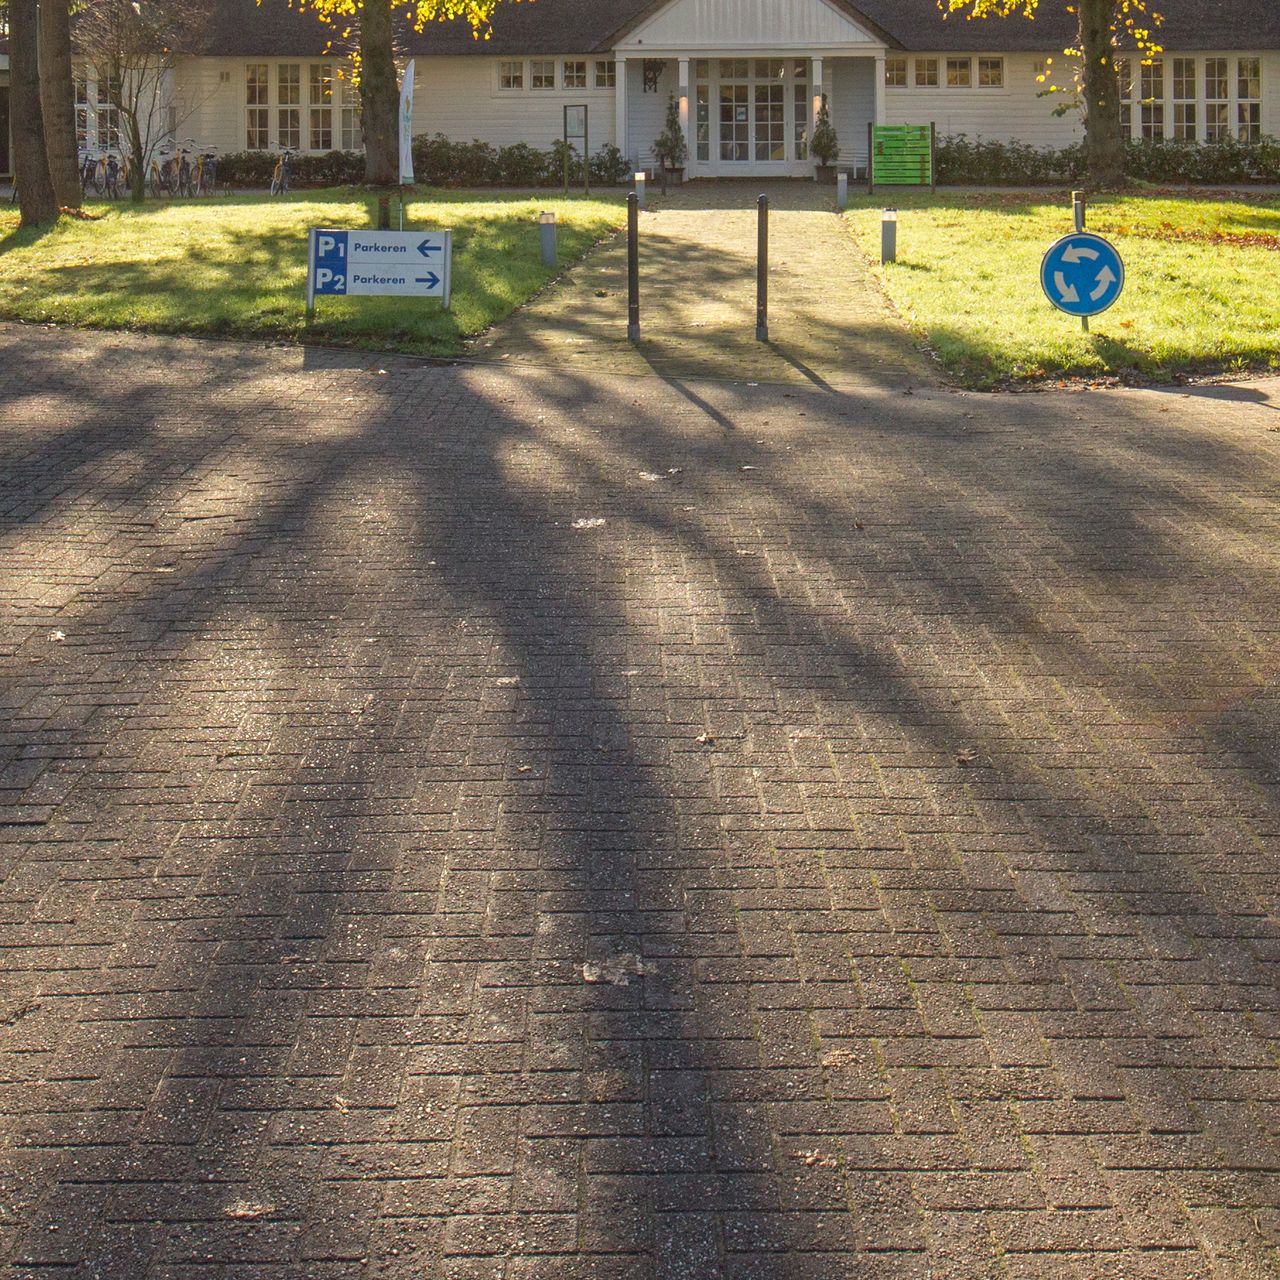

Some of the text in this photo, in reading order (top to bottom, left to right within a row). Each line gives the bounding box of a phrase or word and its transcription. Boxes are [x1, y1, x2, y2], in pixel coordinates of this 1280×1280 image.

[318, 235, 407, 257] P1 Parkeren
[316, 268, 406, 290] P2 Parkeren
